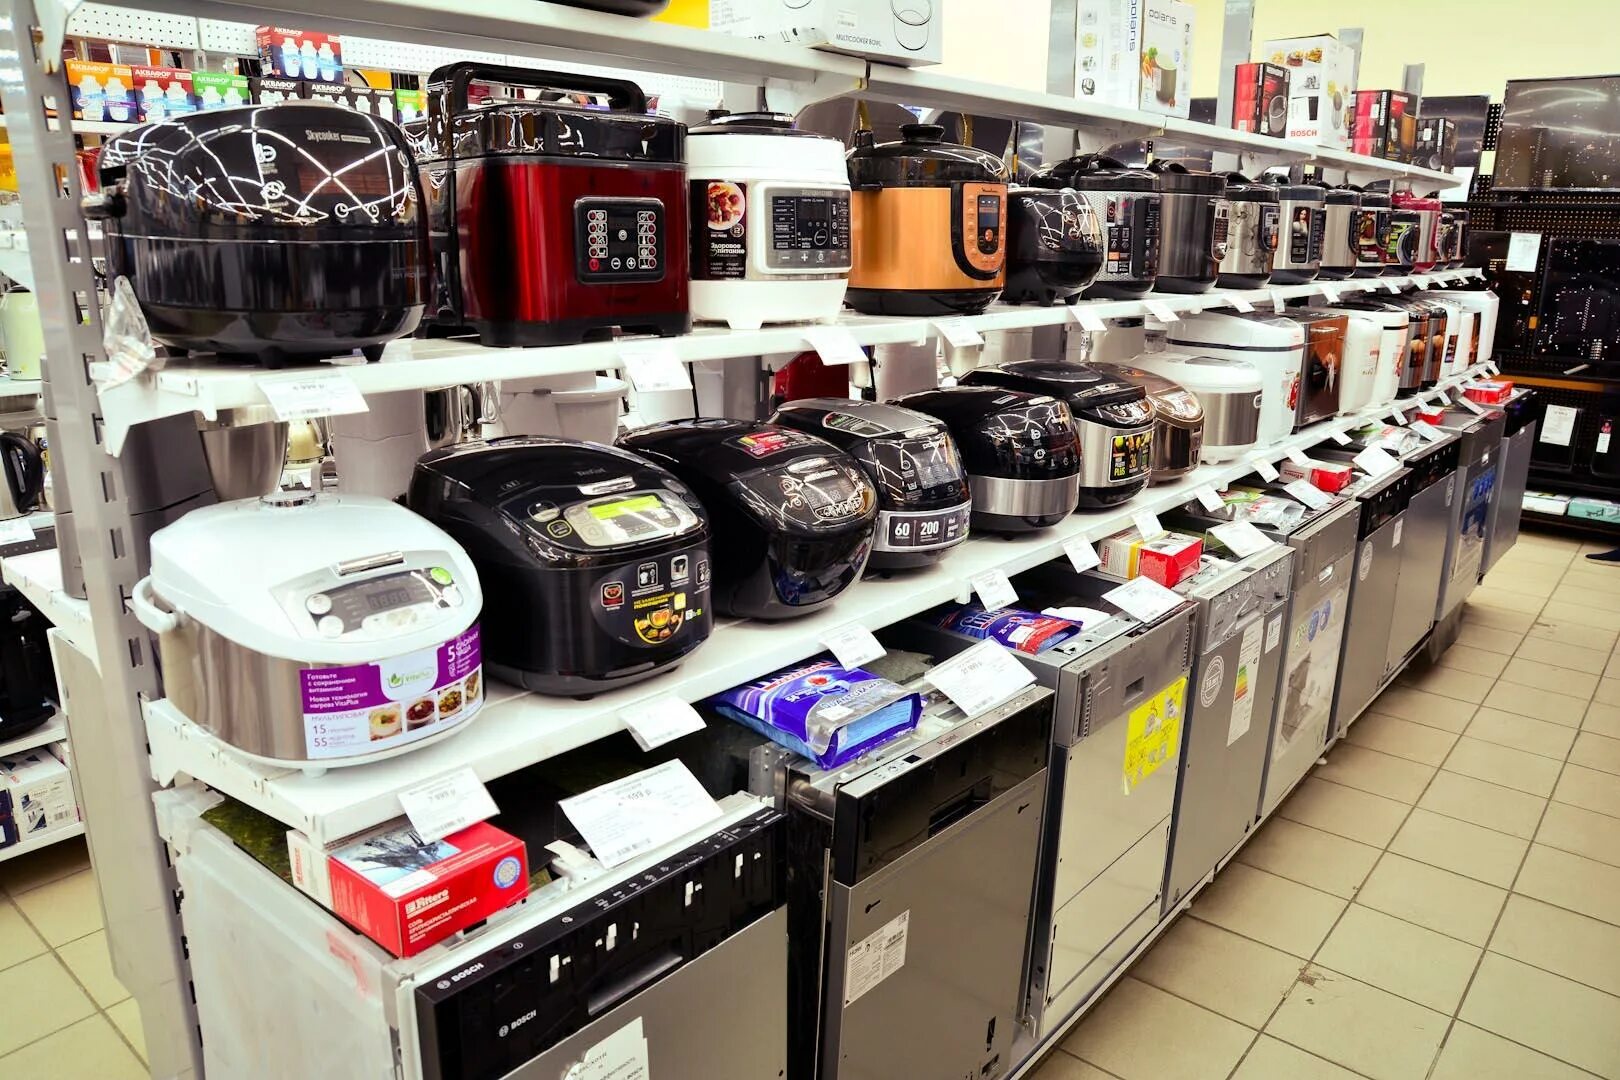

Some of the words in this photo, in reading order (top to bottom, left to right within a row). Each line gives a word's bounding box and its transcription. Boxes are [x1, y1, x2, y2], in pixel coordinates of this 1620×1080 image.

[1148, 9, 1177, 25] polaris
[835, 33, 869, 45] MULTICOOKER
[868, 38, 882, 47] BOWL
[134, 68, 172, 78] АКВАФОР
[260, 79, 297, 88] АКВАФОР
[311, 83, 346, 93] АКВАФОР
[305, 129, 341, 143] Skycooker
[1290, 129, 1317, 138] BOSCH
[710, 242, 742, 250] Здоровое
[894, 522, 910, 536] 60
[920, 520, 940, 535] 200
[447, 645, 456, 663] 5
[313, 677, 356, 687] сохранением
[331, 692, 368, 702] технология
[334, 699, 360, 707] VitaPlus
[313, 724, 327, 735] 15
[313, 737, 328, 748] 55
[415, 888, 449, 910] Filtero
[407, 918, 424, 929] СОЛЬ
[451, 962, 485, 983] BOSCH
[510, 1009, 537, 1031] BOSCH
